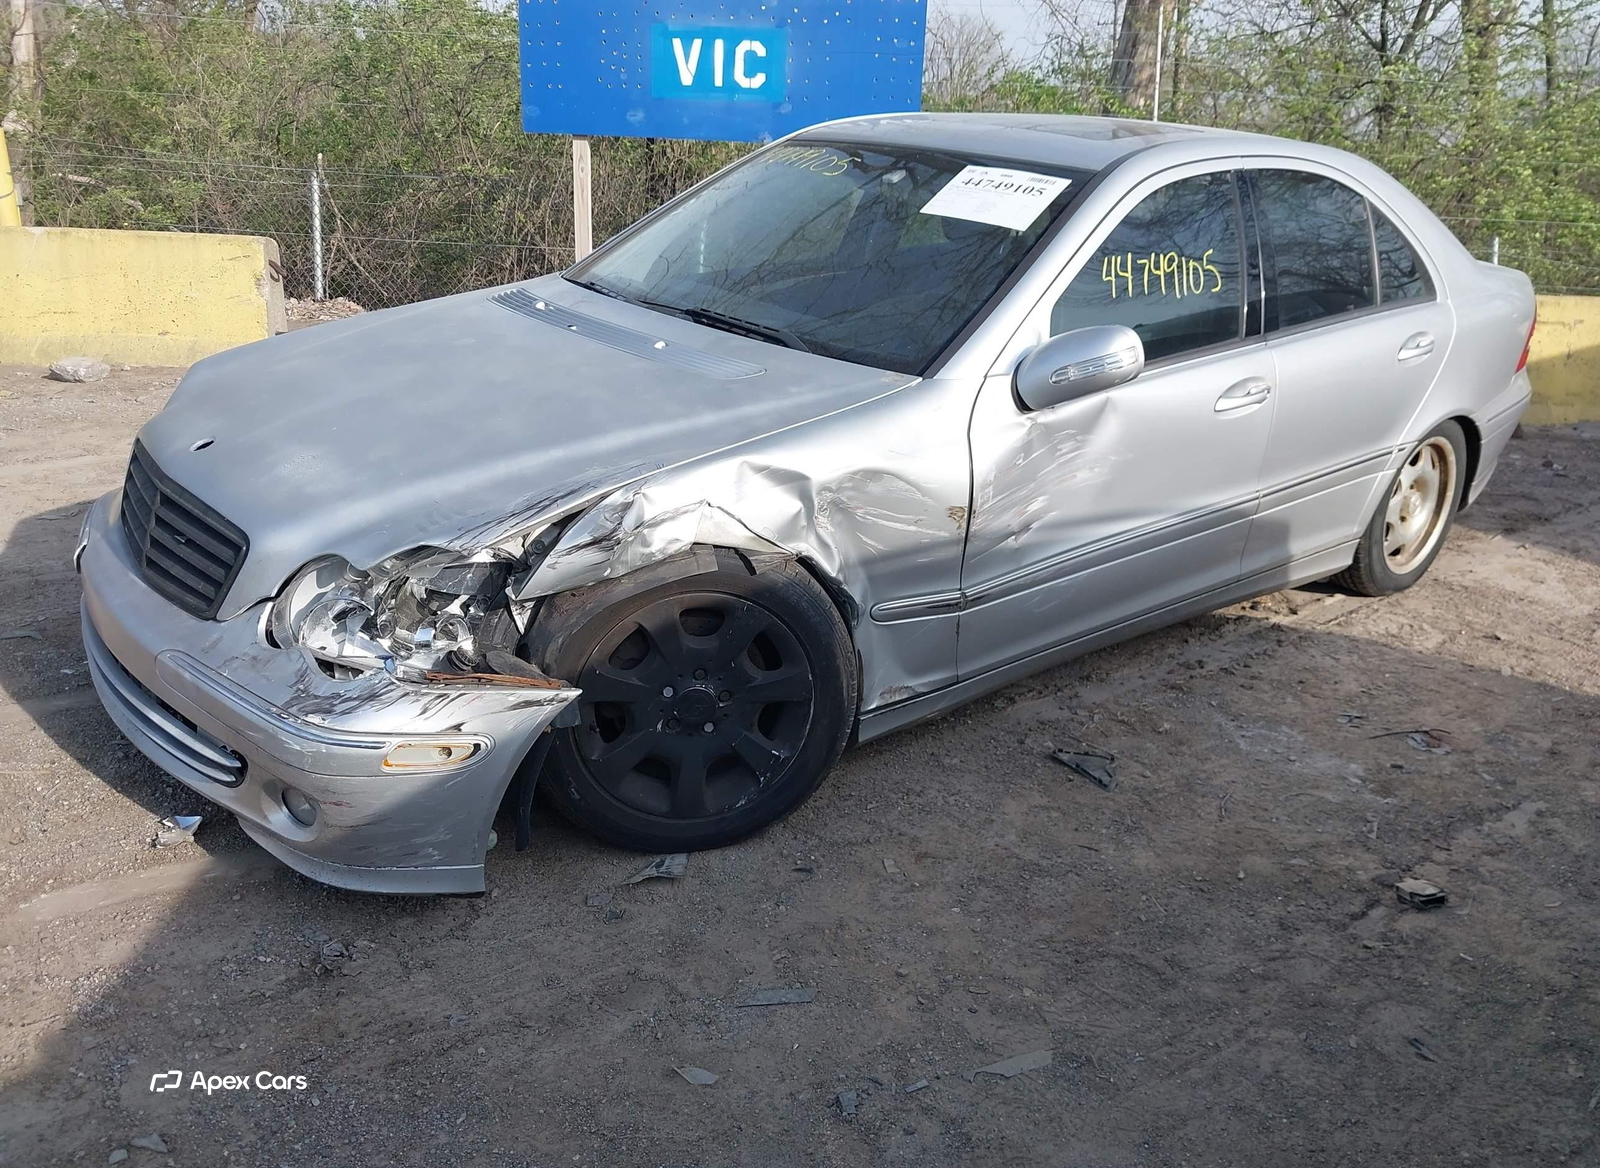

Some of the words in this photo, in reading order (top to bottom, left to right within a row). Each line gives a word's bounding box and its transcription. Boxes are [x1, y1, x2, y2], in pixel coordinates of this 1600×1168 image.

[671, 37, 767, 89] VIC
[960, 177, 1047, 197] 44749105
[1102, 248, 1222, 299] 44749105
